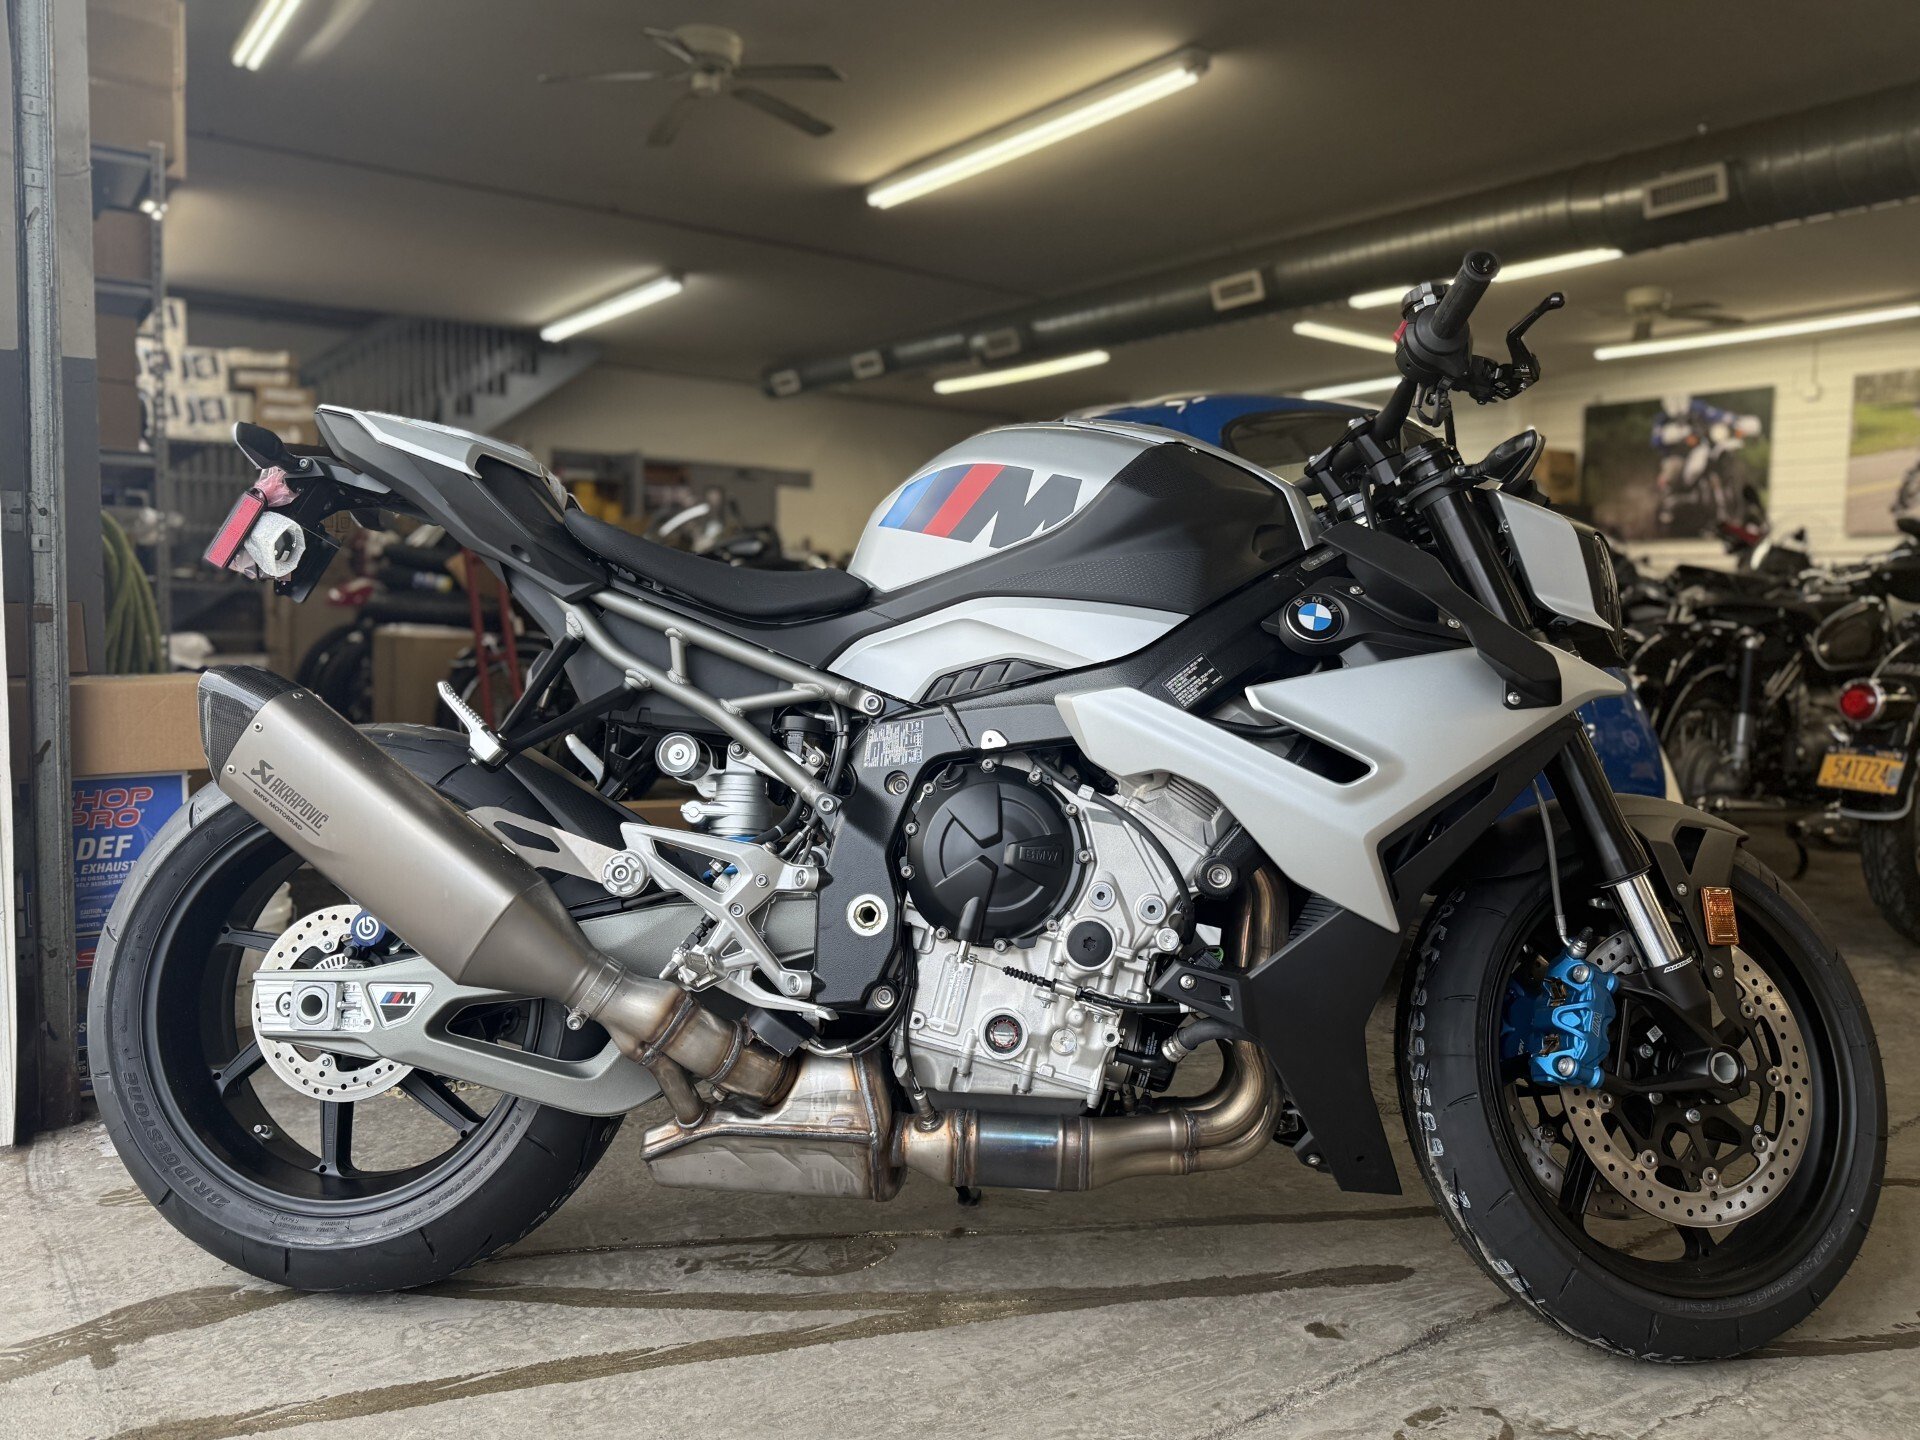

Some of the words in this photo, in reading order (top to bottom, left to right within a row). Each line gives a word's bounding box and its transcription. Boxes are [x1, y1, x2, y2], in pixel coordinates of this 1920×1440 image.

[1294, 596, 1339, 613] BMW
[72, 786, 154, 811] HOP
[252, 788, 270, 803] BMW
[268, 801, 303, 831] MOTORRAD
[76, 834, 134, 861] DEF
[1025, 849, 1059, 862] BMW
[81, 860, 138, 875] EXHAUST
[123, 1071, 231, 1209] BRIDGESTONE
